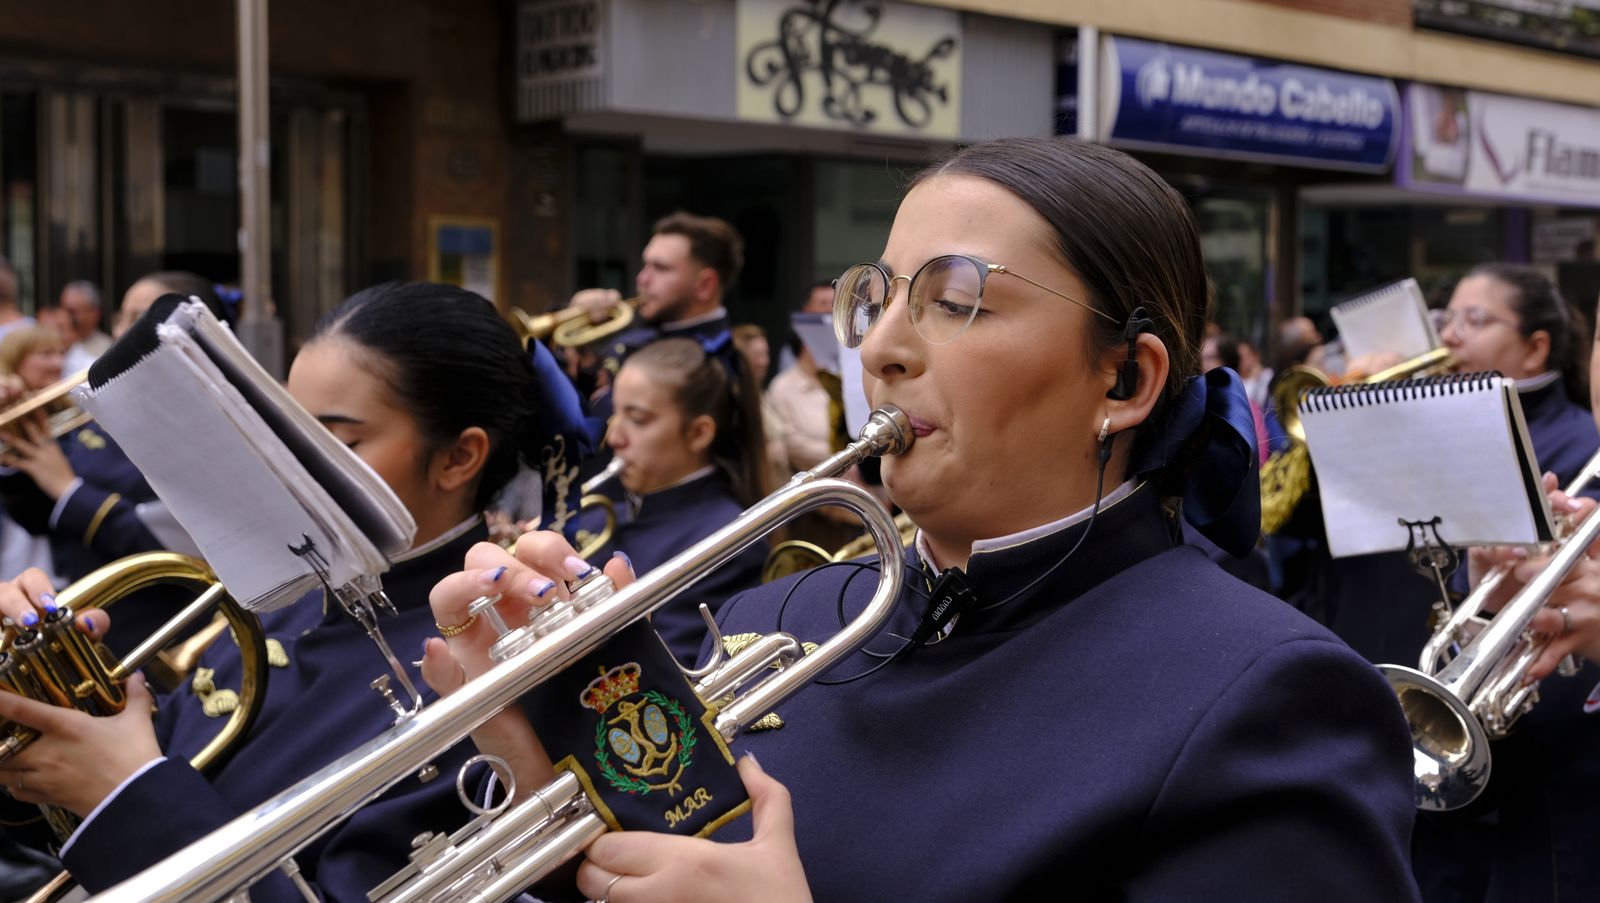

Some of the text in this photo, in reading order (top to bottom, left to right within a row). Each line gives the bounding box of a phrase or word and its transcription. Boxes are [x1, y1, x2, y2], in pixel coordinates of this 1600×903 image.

[1171, 62, 1385, 129] Mundo Cabello
[664, 787, 713, 828] MAR
